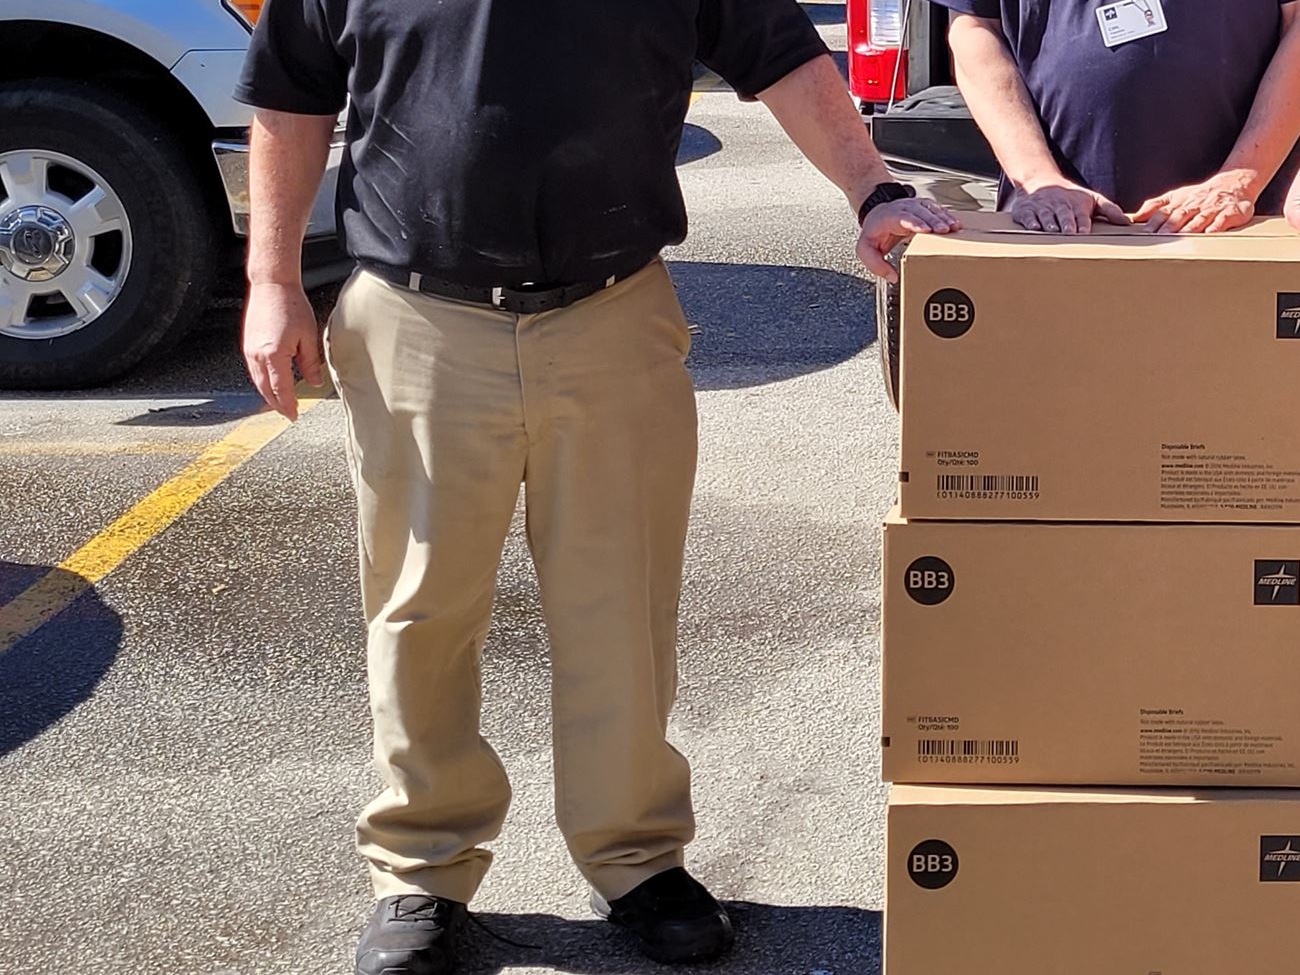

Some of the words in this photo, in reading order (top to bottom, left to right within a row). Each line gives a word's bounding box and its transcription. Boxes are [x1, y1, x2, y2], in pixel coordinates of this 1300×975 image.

[929, 303, 969, 322] BB3
[910, 570, 949, 589] BB3
[912, 854, 952, 872] BB3
